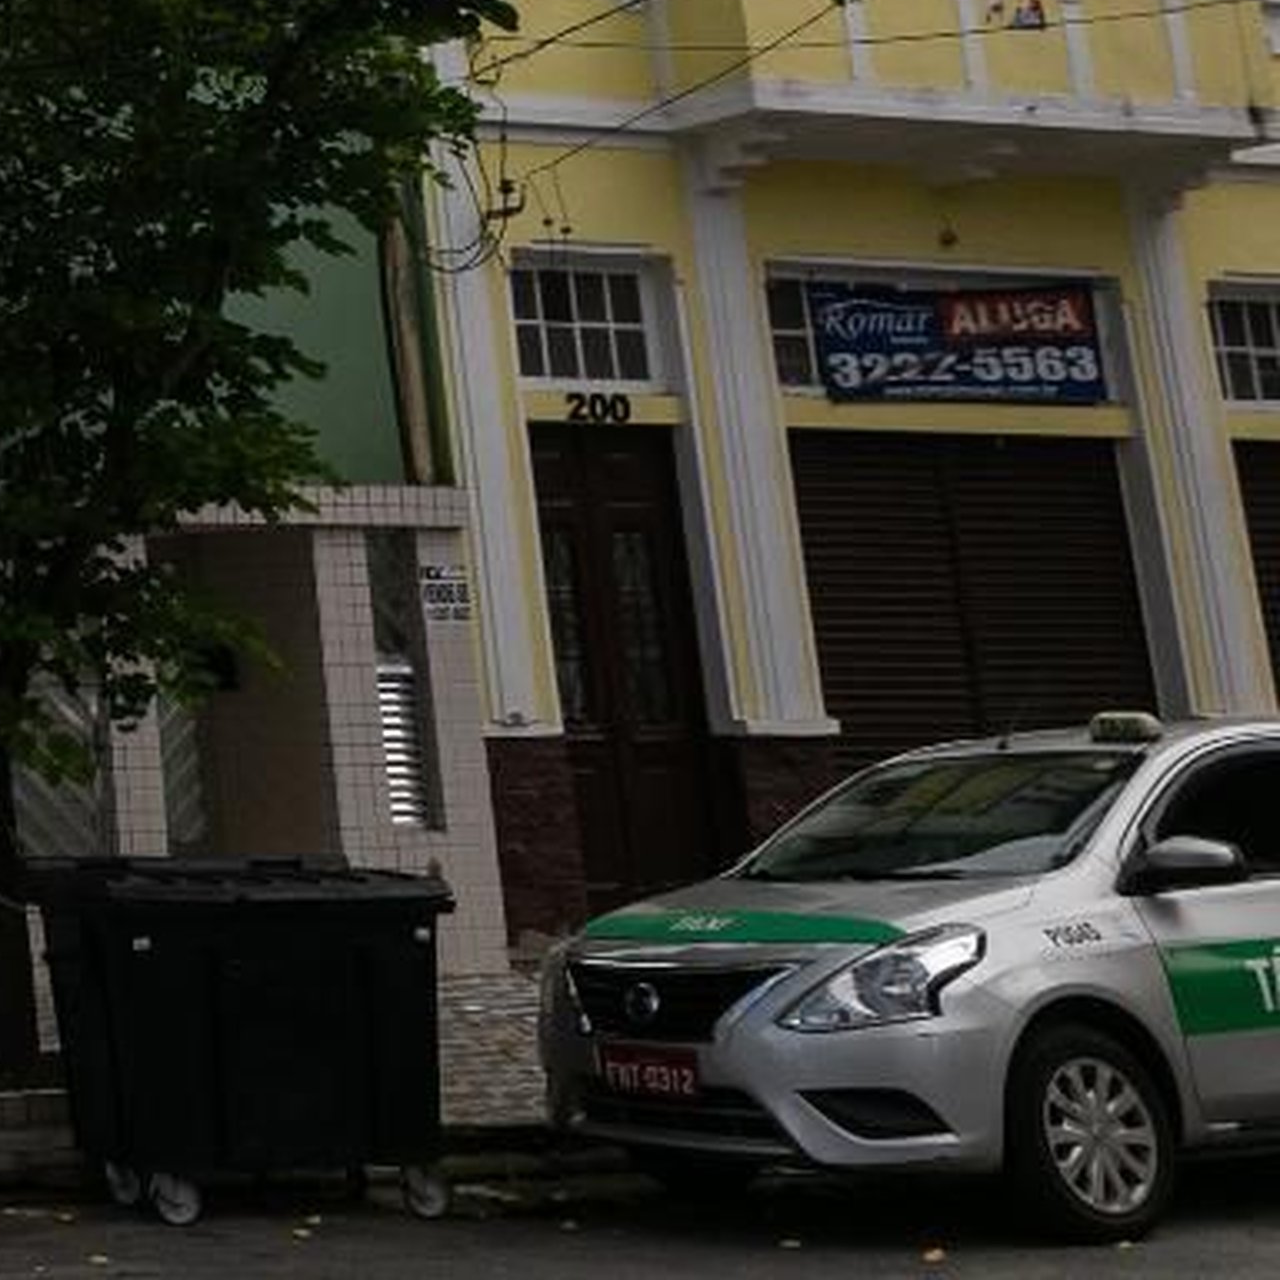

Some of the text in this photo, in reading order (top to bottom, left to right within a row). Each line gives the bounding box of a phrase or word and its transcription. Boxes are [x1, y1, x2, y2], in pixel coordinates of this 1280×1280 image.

[950, 298, 1083, 335] ALUGA
[827, 345, 1099, 389] 3222-5563
[565, 392, 631, 423] 200
